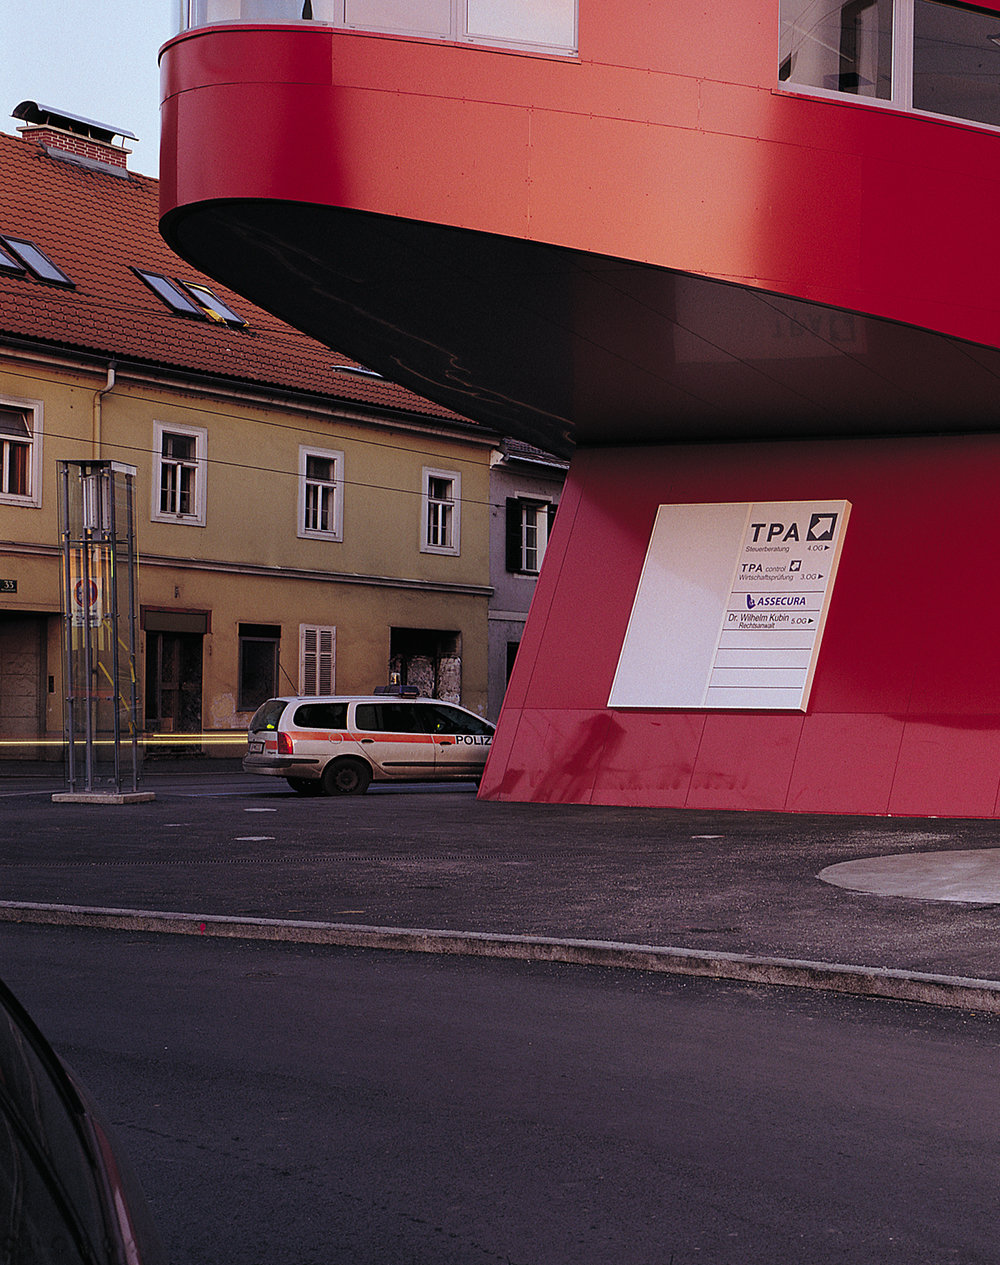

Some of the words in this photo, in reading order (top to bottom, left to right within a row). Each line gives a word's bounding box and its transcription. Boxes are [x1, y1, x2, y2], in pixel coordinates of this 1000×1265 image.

[751, 522, 800, 542] TPA
[745, 545, 790, 553] Steuerberatung
[807, 544, 824, 552] 4.OG
[742, 564, 763, 572] TPA
[4, 580, 14, 588] 33
[757, 597, 806, 606] ASSECURA
[728, 613, 738, 622] Dr.
[740, 613, 768, 622] Wilhelm
[769, 613, 790, 622] Kubin
[456, 736, 493, 745] POLIZ
